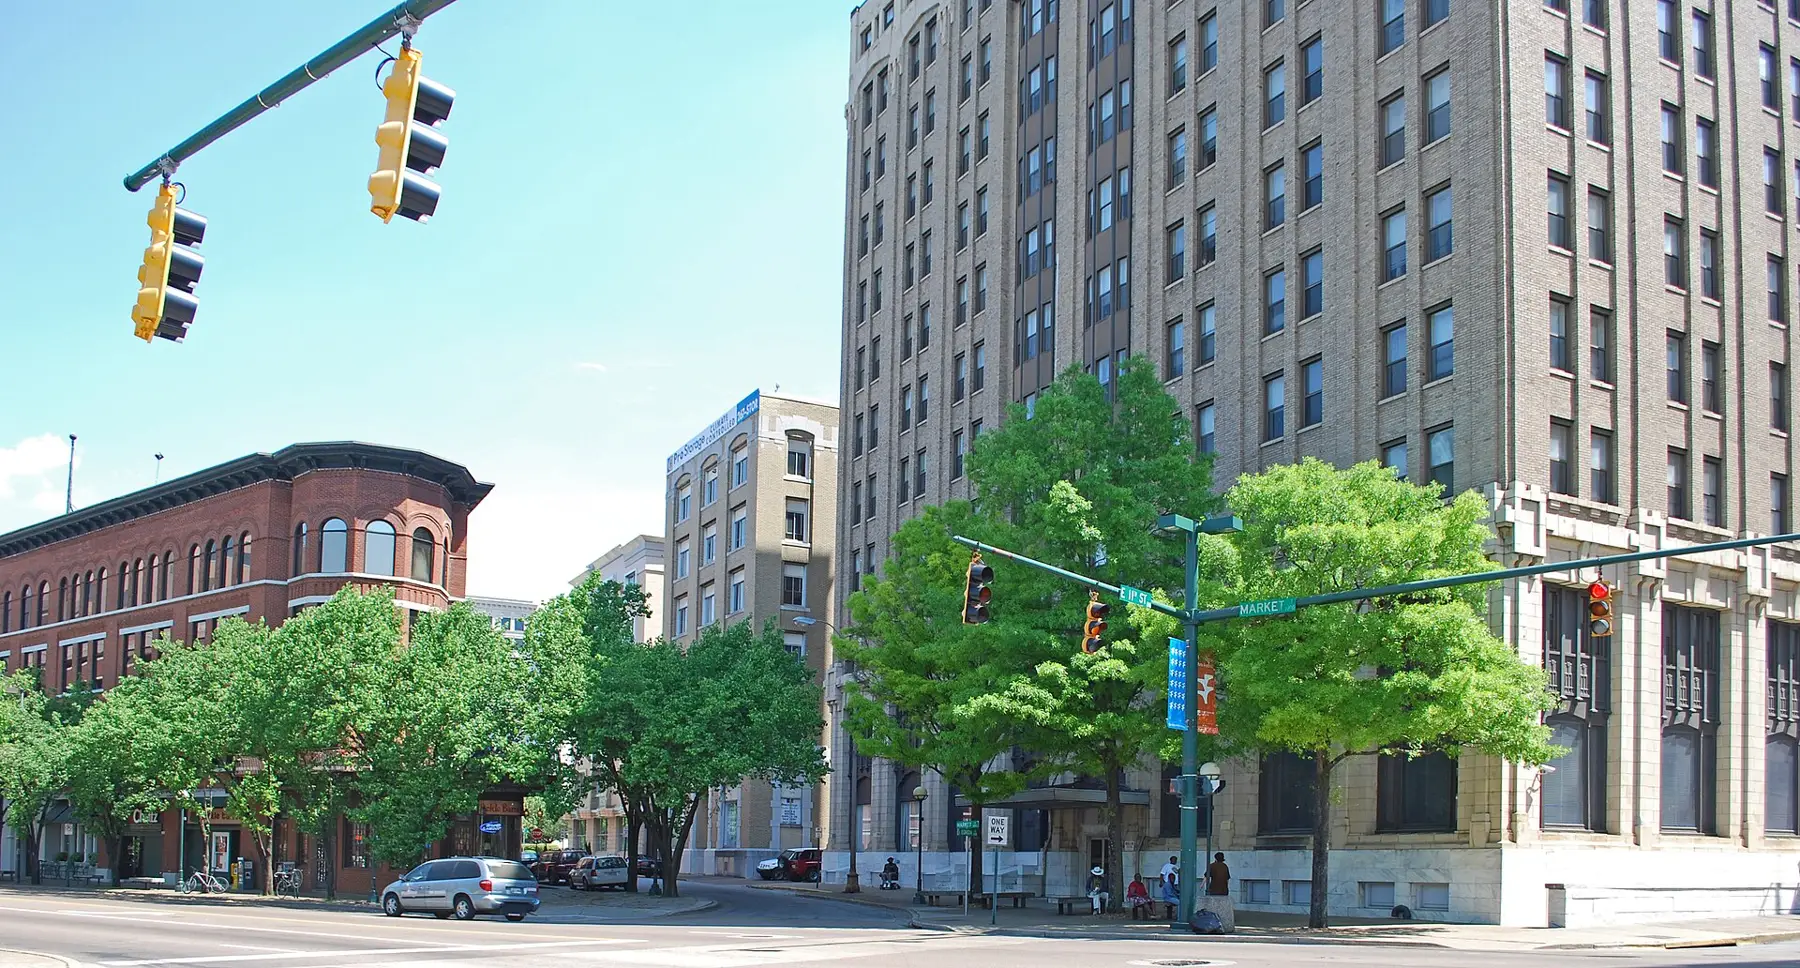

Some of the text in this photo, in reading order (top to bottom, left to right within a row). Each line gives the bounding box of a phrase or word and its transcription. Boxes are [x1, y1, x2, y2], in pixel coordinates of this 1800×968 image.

[705, 418, 736, 445] CONTROLLED
[709, 413, 729, 433] CLIMATE
[1120, 586, 1126, 599] E
[1139, 593, 1148, 605] ST
[1240, 600, 1285, 615] MARKET
[991, 818, 1004, 826] ONE
